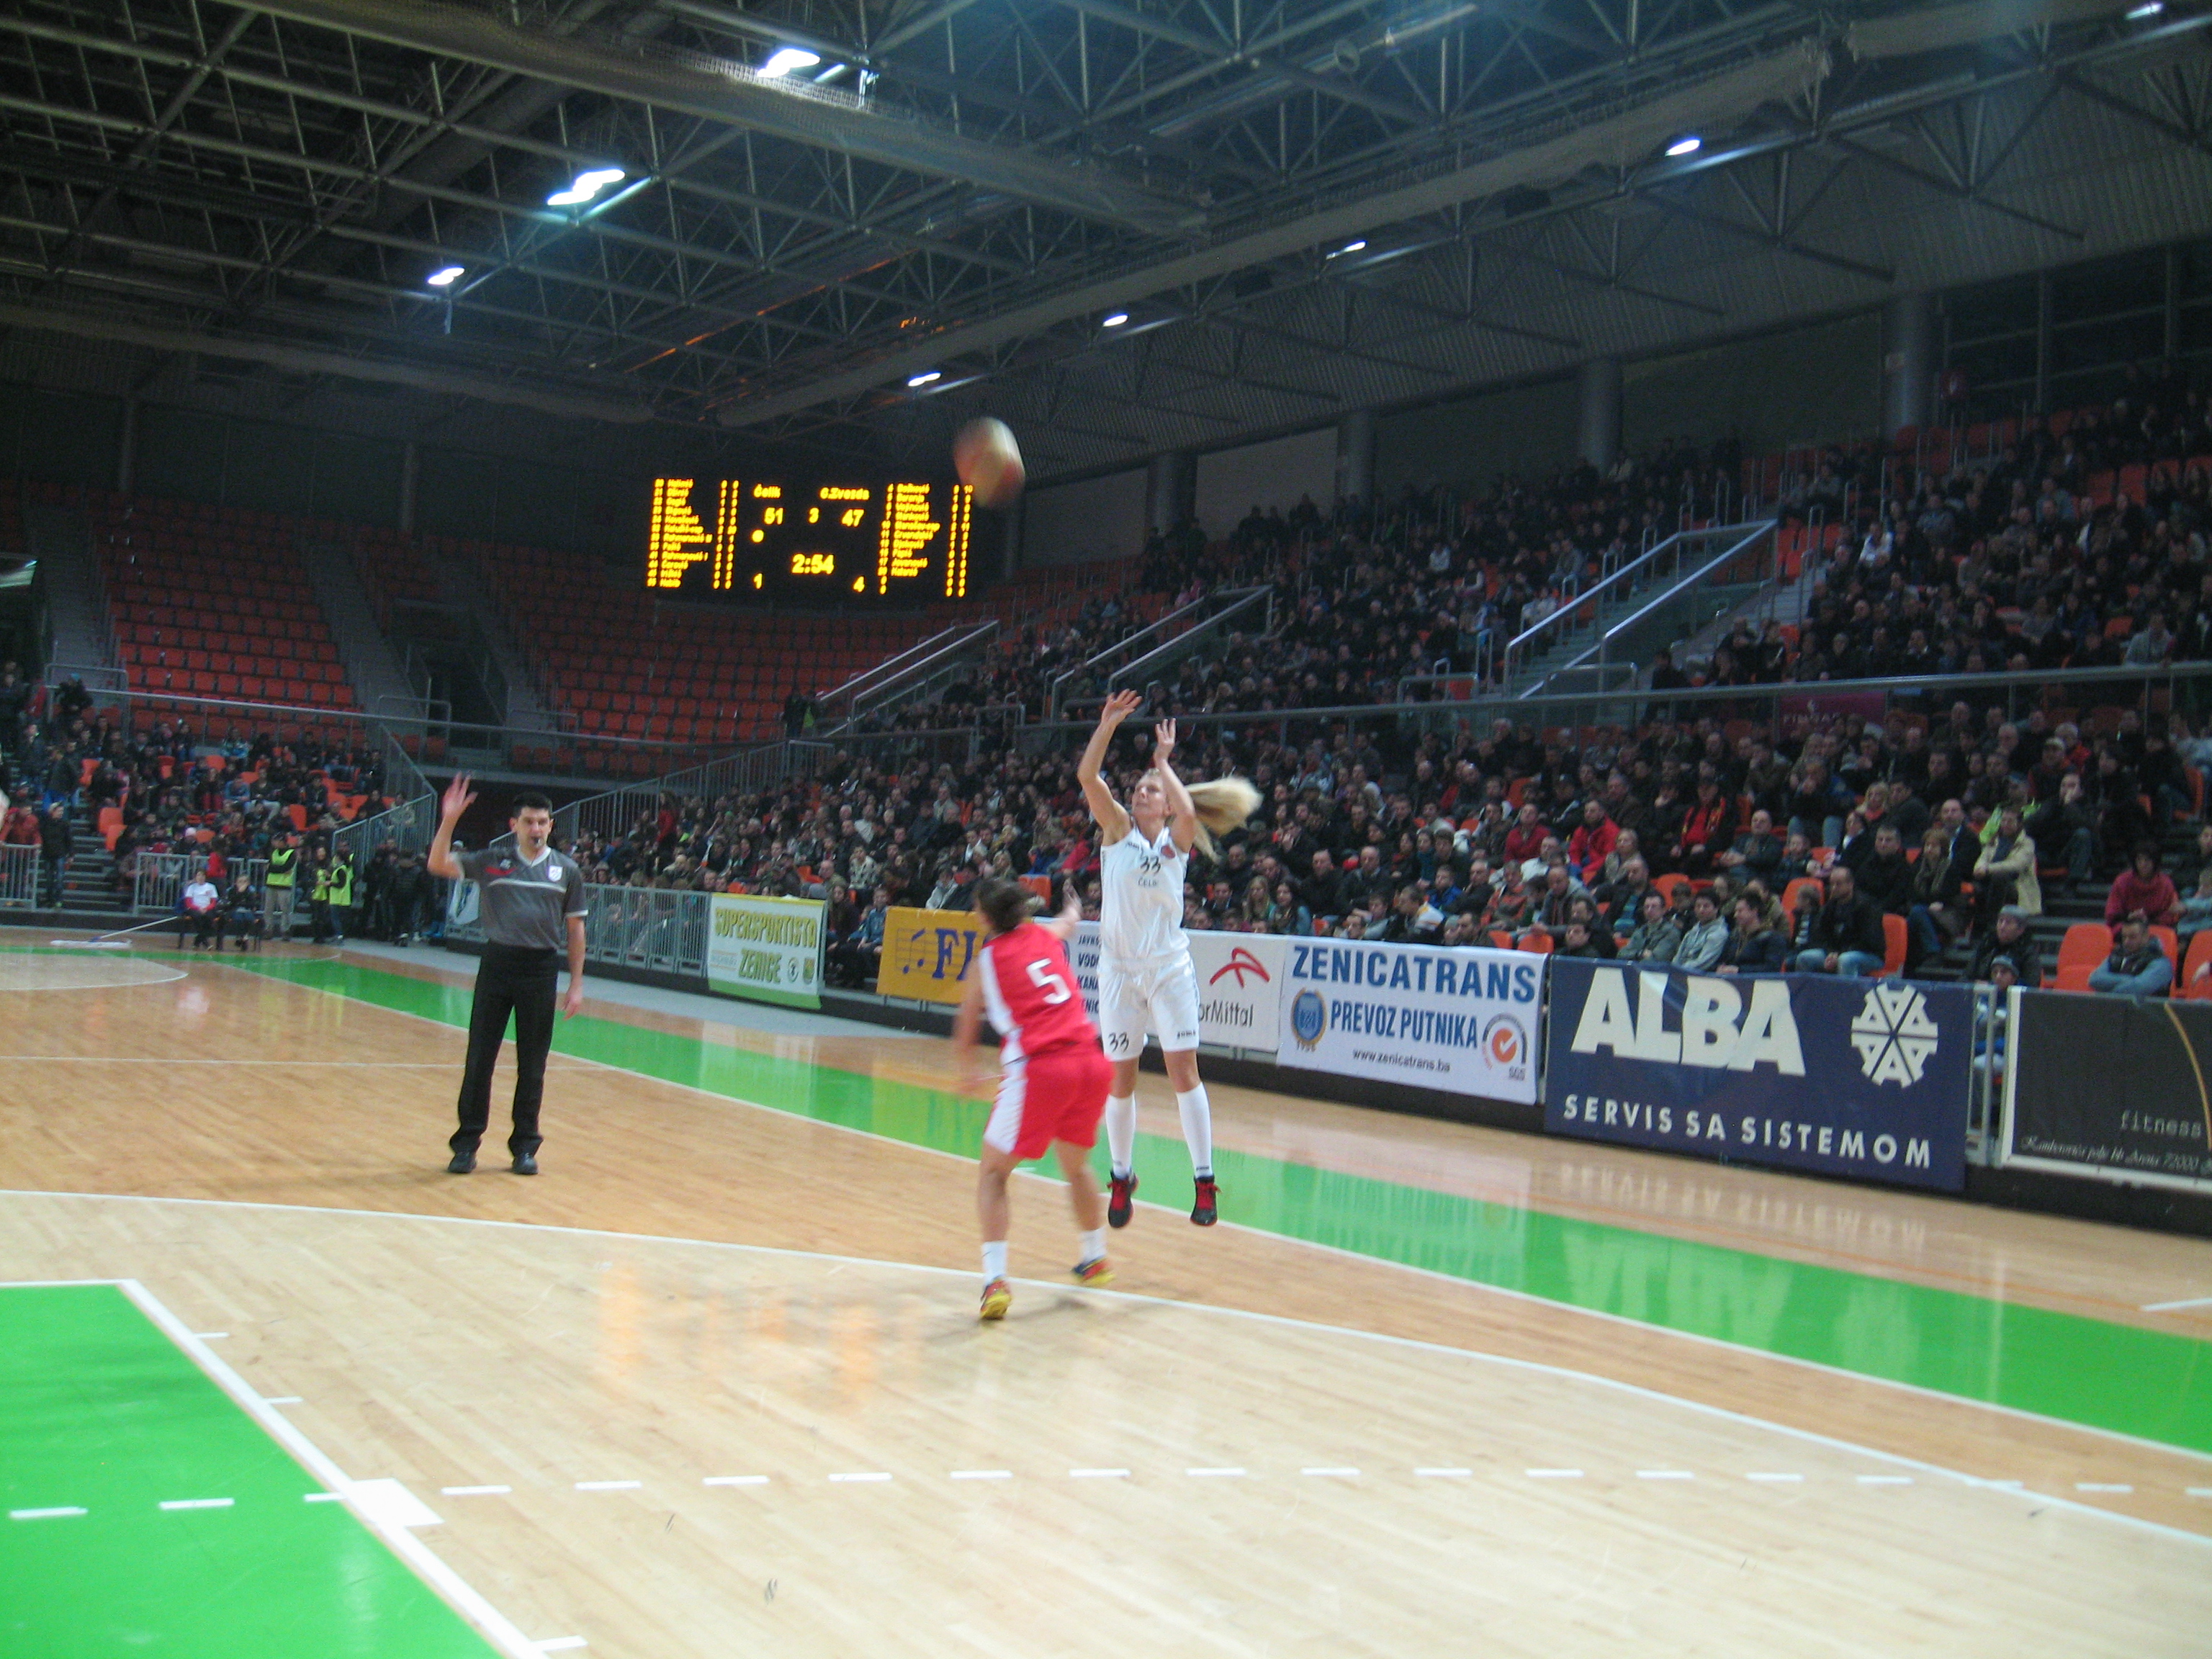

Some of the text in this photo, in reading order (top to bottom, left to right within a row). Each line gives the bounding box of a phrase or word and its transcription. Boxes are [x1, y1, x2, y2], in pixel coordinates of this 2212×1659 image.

[753, 484, 782, 498] Čelik
[964, 485, 973, 494] 10
[764, 507, 784, 525] 51
[808, 507, 820, 523] 3
[841, 509, 865, 526] 47
[791, 553, 835, 574] 2:54
[753, 573, 763, 589] 1
[853, 576, 866, 592] 4
[715, 907, 817, 948] SUPERSPORTISTA
[739, 948, 782, 984] ZENICE
[1292, 945, 1536, 1003] ZENICATRANS
[1025, 958, 1072, 1005] 5
[1330, 999, 1397, 1037] PREVOZ
[1400, 1009, 1478, 1049] PUTNIKA
[1570, 966, 1806, 1077] ALBA
[1108, 1032, 1130, 1053] 33
[1352, 1048, 1451, 1073] www.zenicatrans.ba
[1563, 1093, 1932, 1169] SERVIS SA SISTEMOM
[2120, 1109, 2201, 1139] fitness
